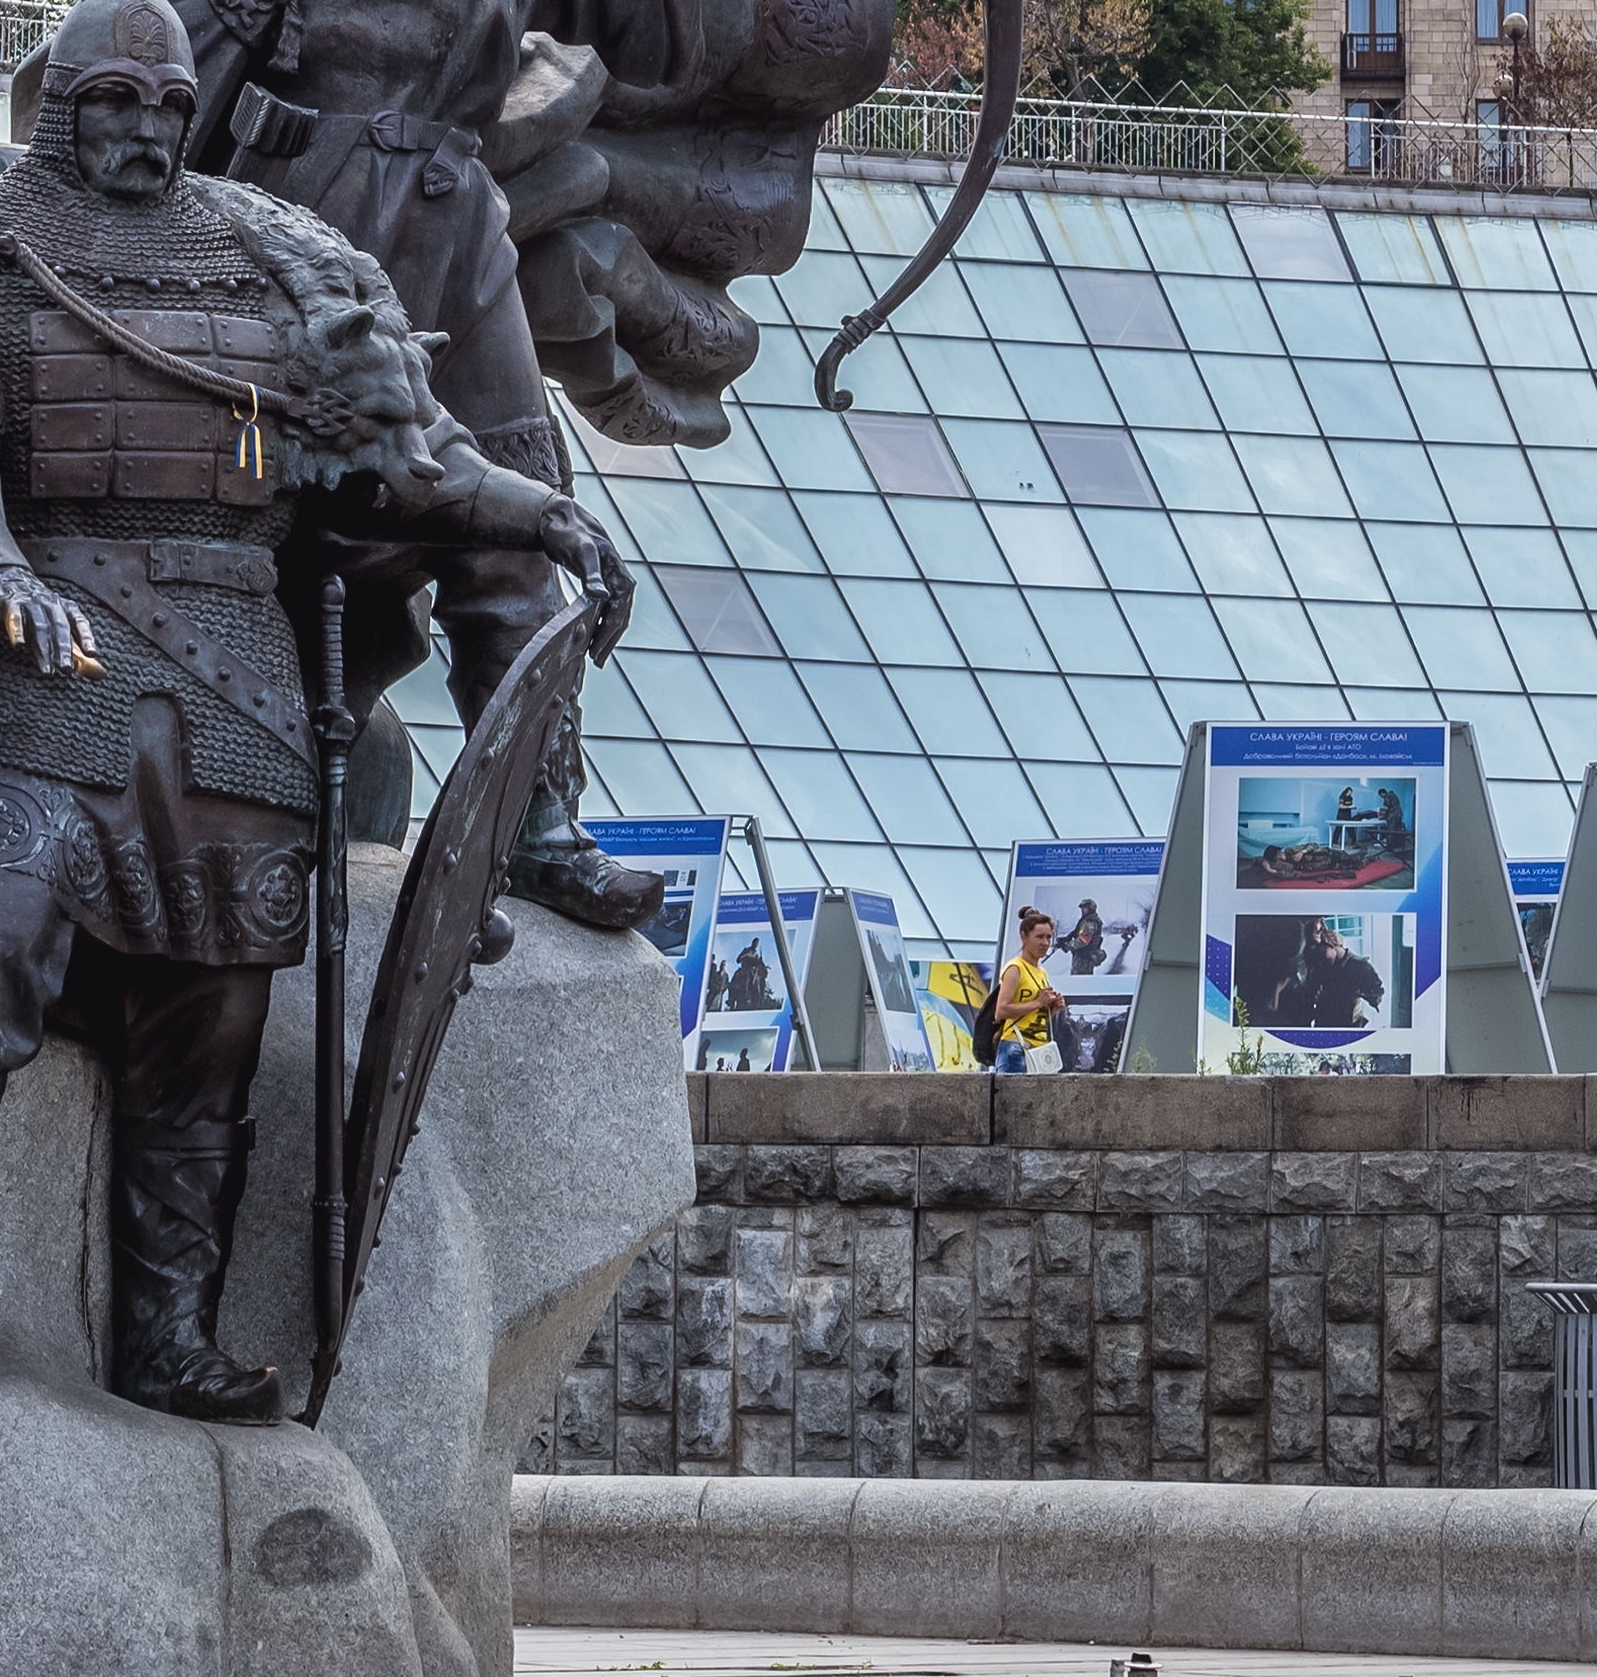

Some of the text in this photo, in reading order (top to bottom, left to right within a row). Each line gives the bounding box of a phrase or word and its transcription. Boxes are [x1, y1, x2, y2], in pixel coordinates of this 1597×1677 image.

[1249, 732, 1285, 742] СЛАВА
[1286, 731, 1323, 741] УКРАЇНІ
[1330, 732, 1368, 741] ГЕРОЯМ
[1370, 732, 1408, 741] СЛАВА!
[587, 827, 606, 836] ЛАВА
[607, 826, 634, 836] УКРАЇНІ
[639, 827, 668, 835] ГЕРОЯМ
[1046, 847, 1071, 856] СЛАВА
[1104, 846, 1133, 855] ГЕРОЯМ
